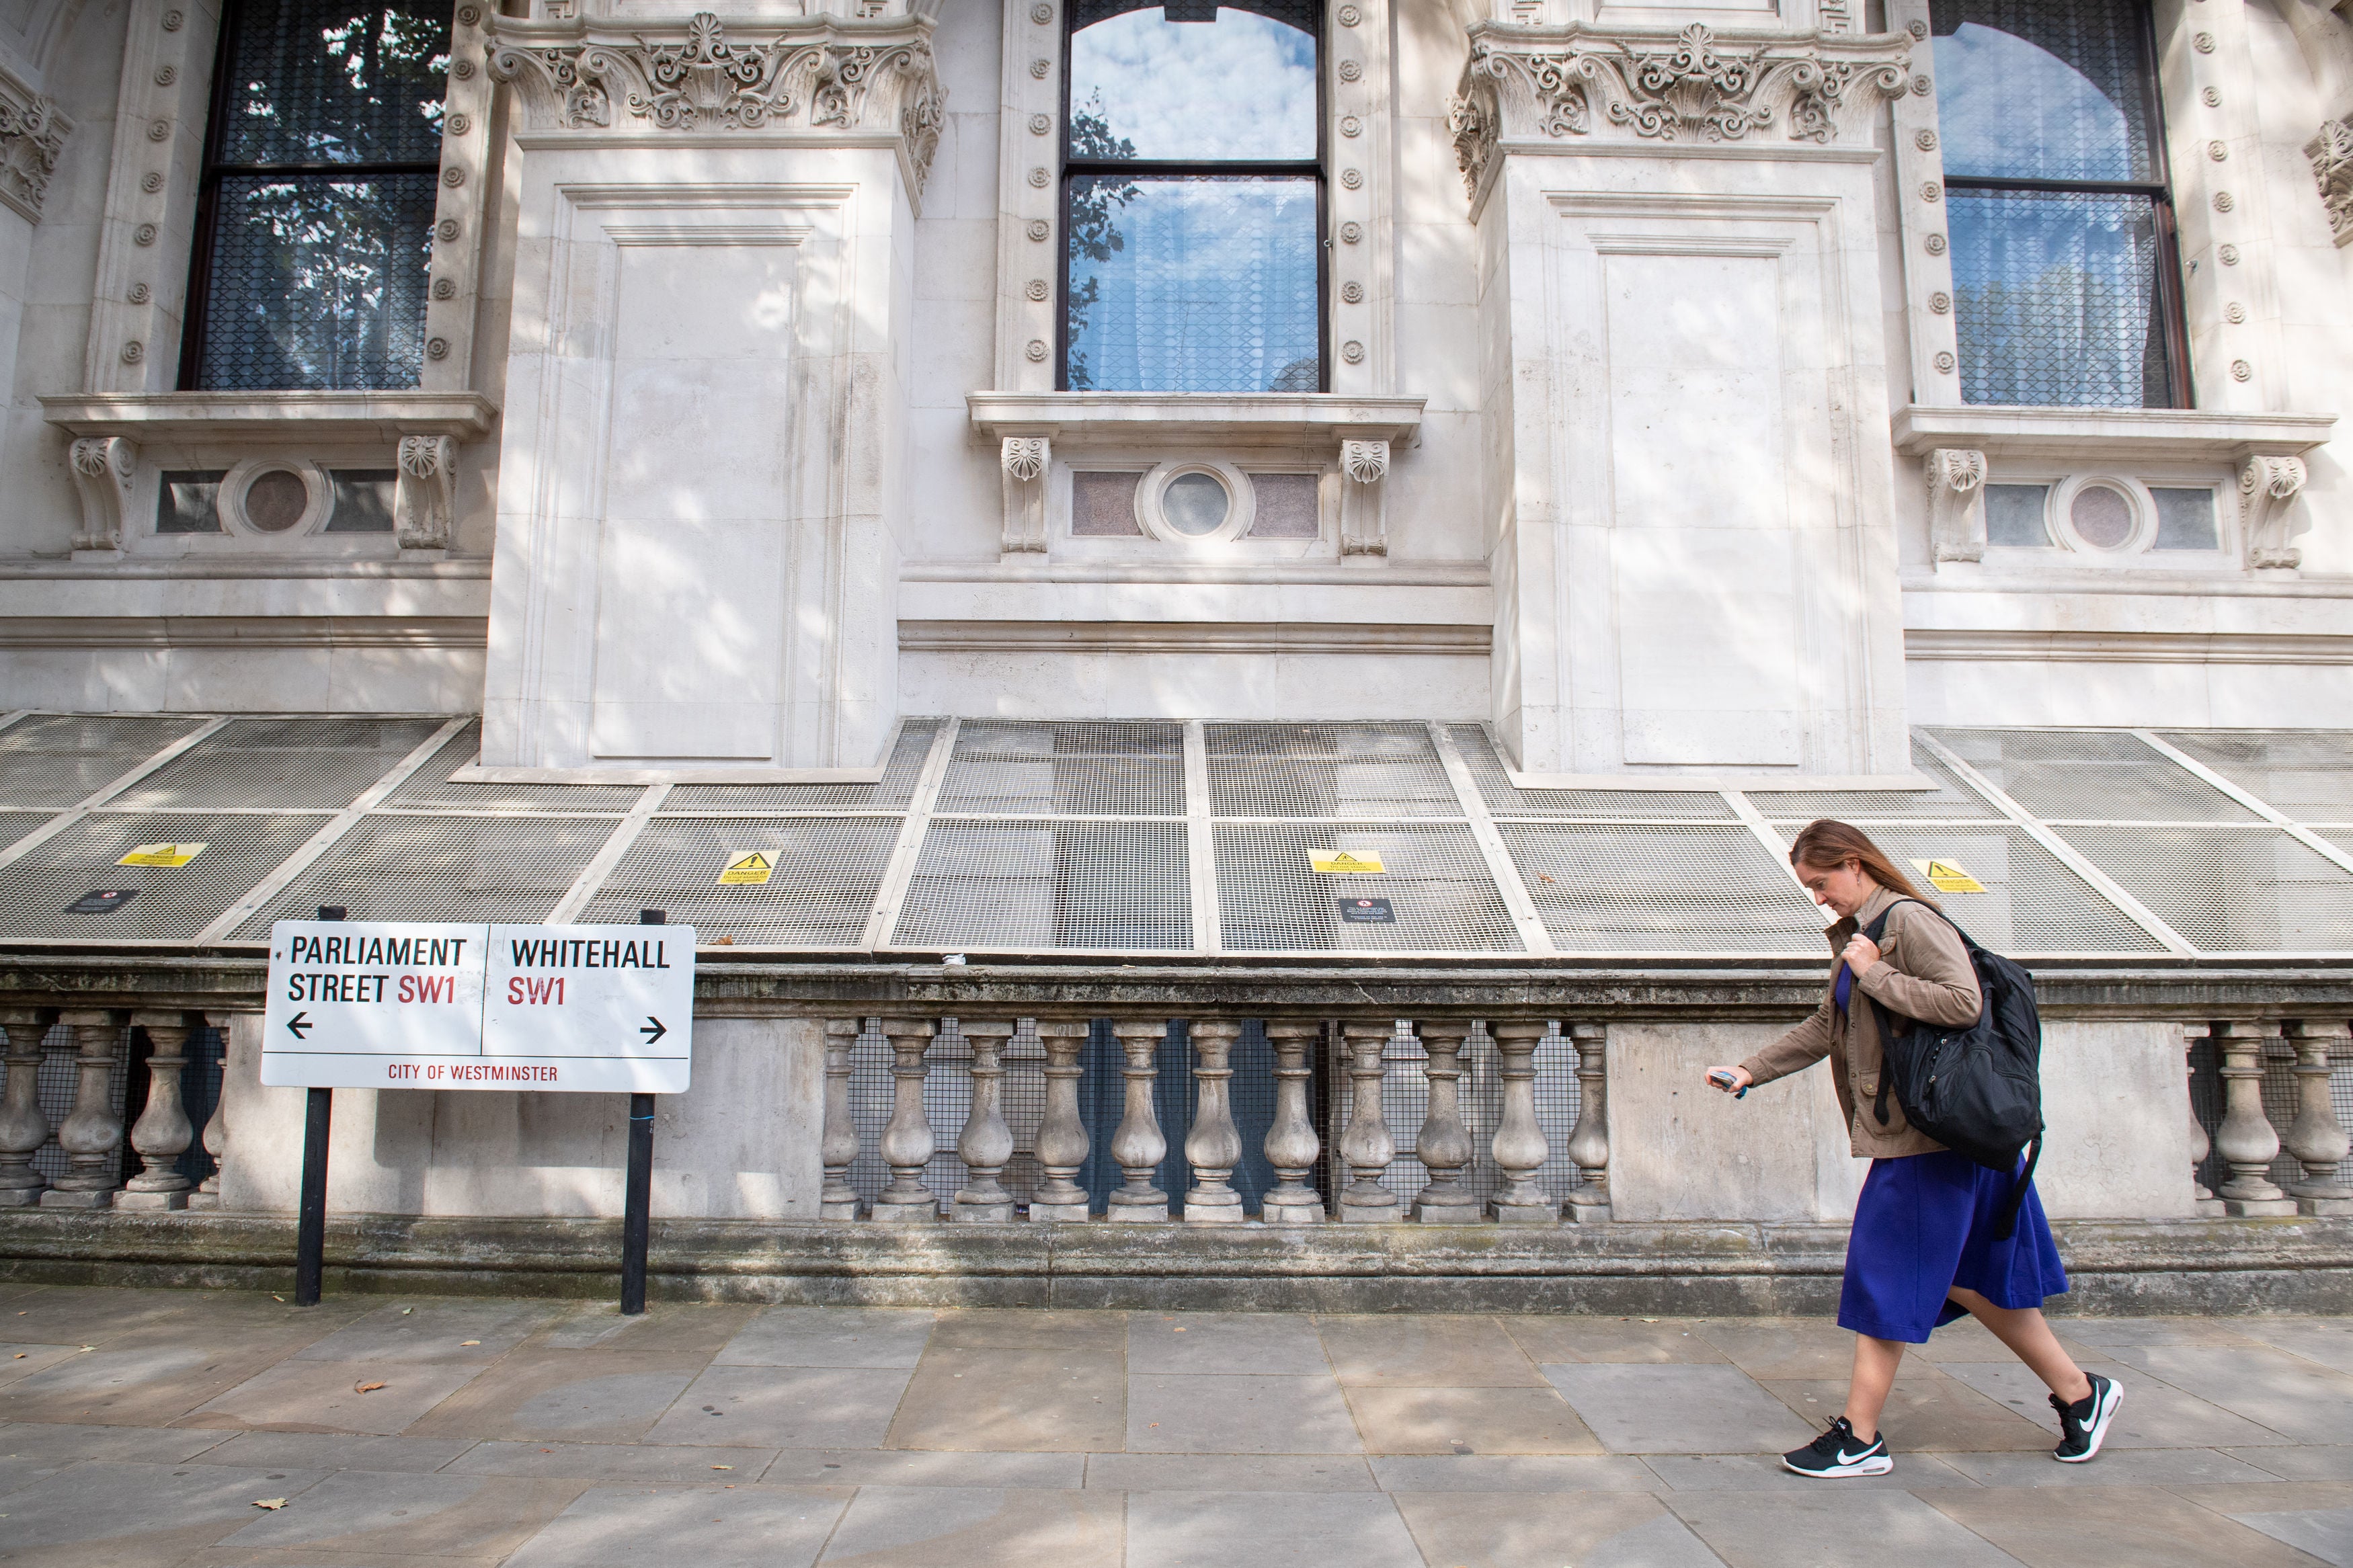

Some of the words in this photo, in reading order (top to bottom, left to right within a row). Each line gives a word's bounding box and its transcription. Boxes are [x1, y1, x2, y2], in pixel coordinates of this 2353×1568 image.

[291, 936, 467, 966] PARLIAMENT
[512, 939, 670, 968] WHITEHALL
[288, 973, 390, 1003] STREET
[398, 975, 454, 1003] SW1
[508, 976, 565, 1005] SW1
[388, 1064, 420, 1079] CITY
[427, 1065, 444, 1080] OF
[450, 1065, 558, 1081] WESTMINSTER
